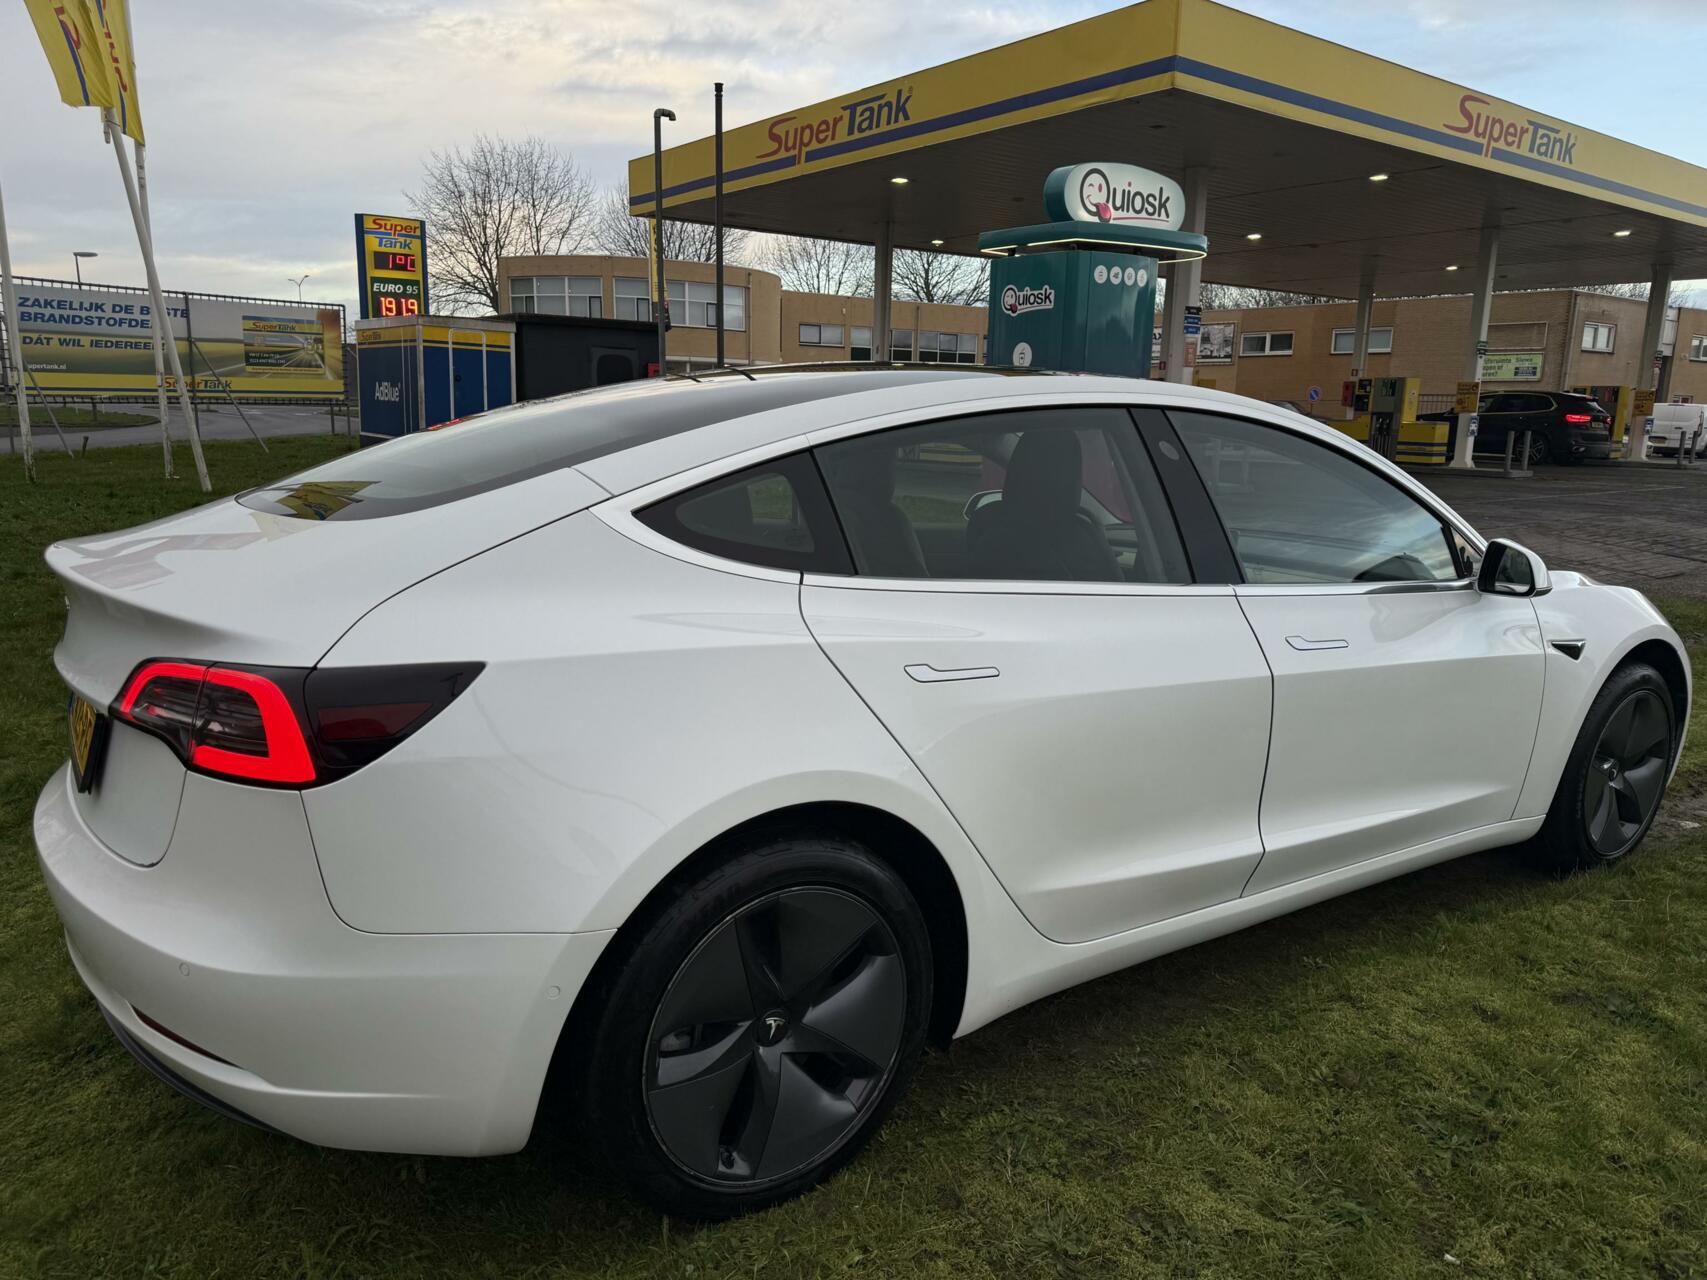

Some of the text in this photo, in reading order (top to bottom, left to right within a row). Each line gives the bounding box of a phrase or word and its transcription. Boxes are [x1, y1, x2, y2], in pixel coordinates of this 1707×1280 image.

[1079, 167, 1170, 223] Quiosk
[365, 217, 420, 237] Super
[374, 236, 412, 250] Tank
[373, 282, 419, 295] EURO 95
[18, 296, 188, 318] ZAKELIJK DE BTE
[1002, 285, 1053, 313] Quiosk
[20, 311, 153, 329] BRANDSTOFDE
[22, 334, 165, 351] DÁT WIL IEDEREE!
